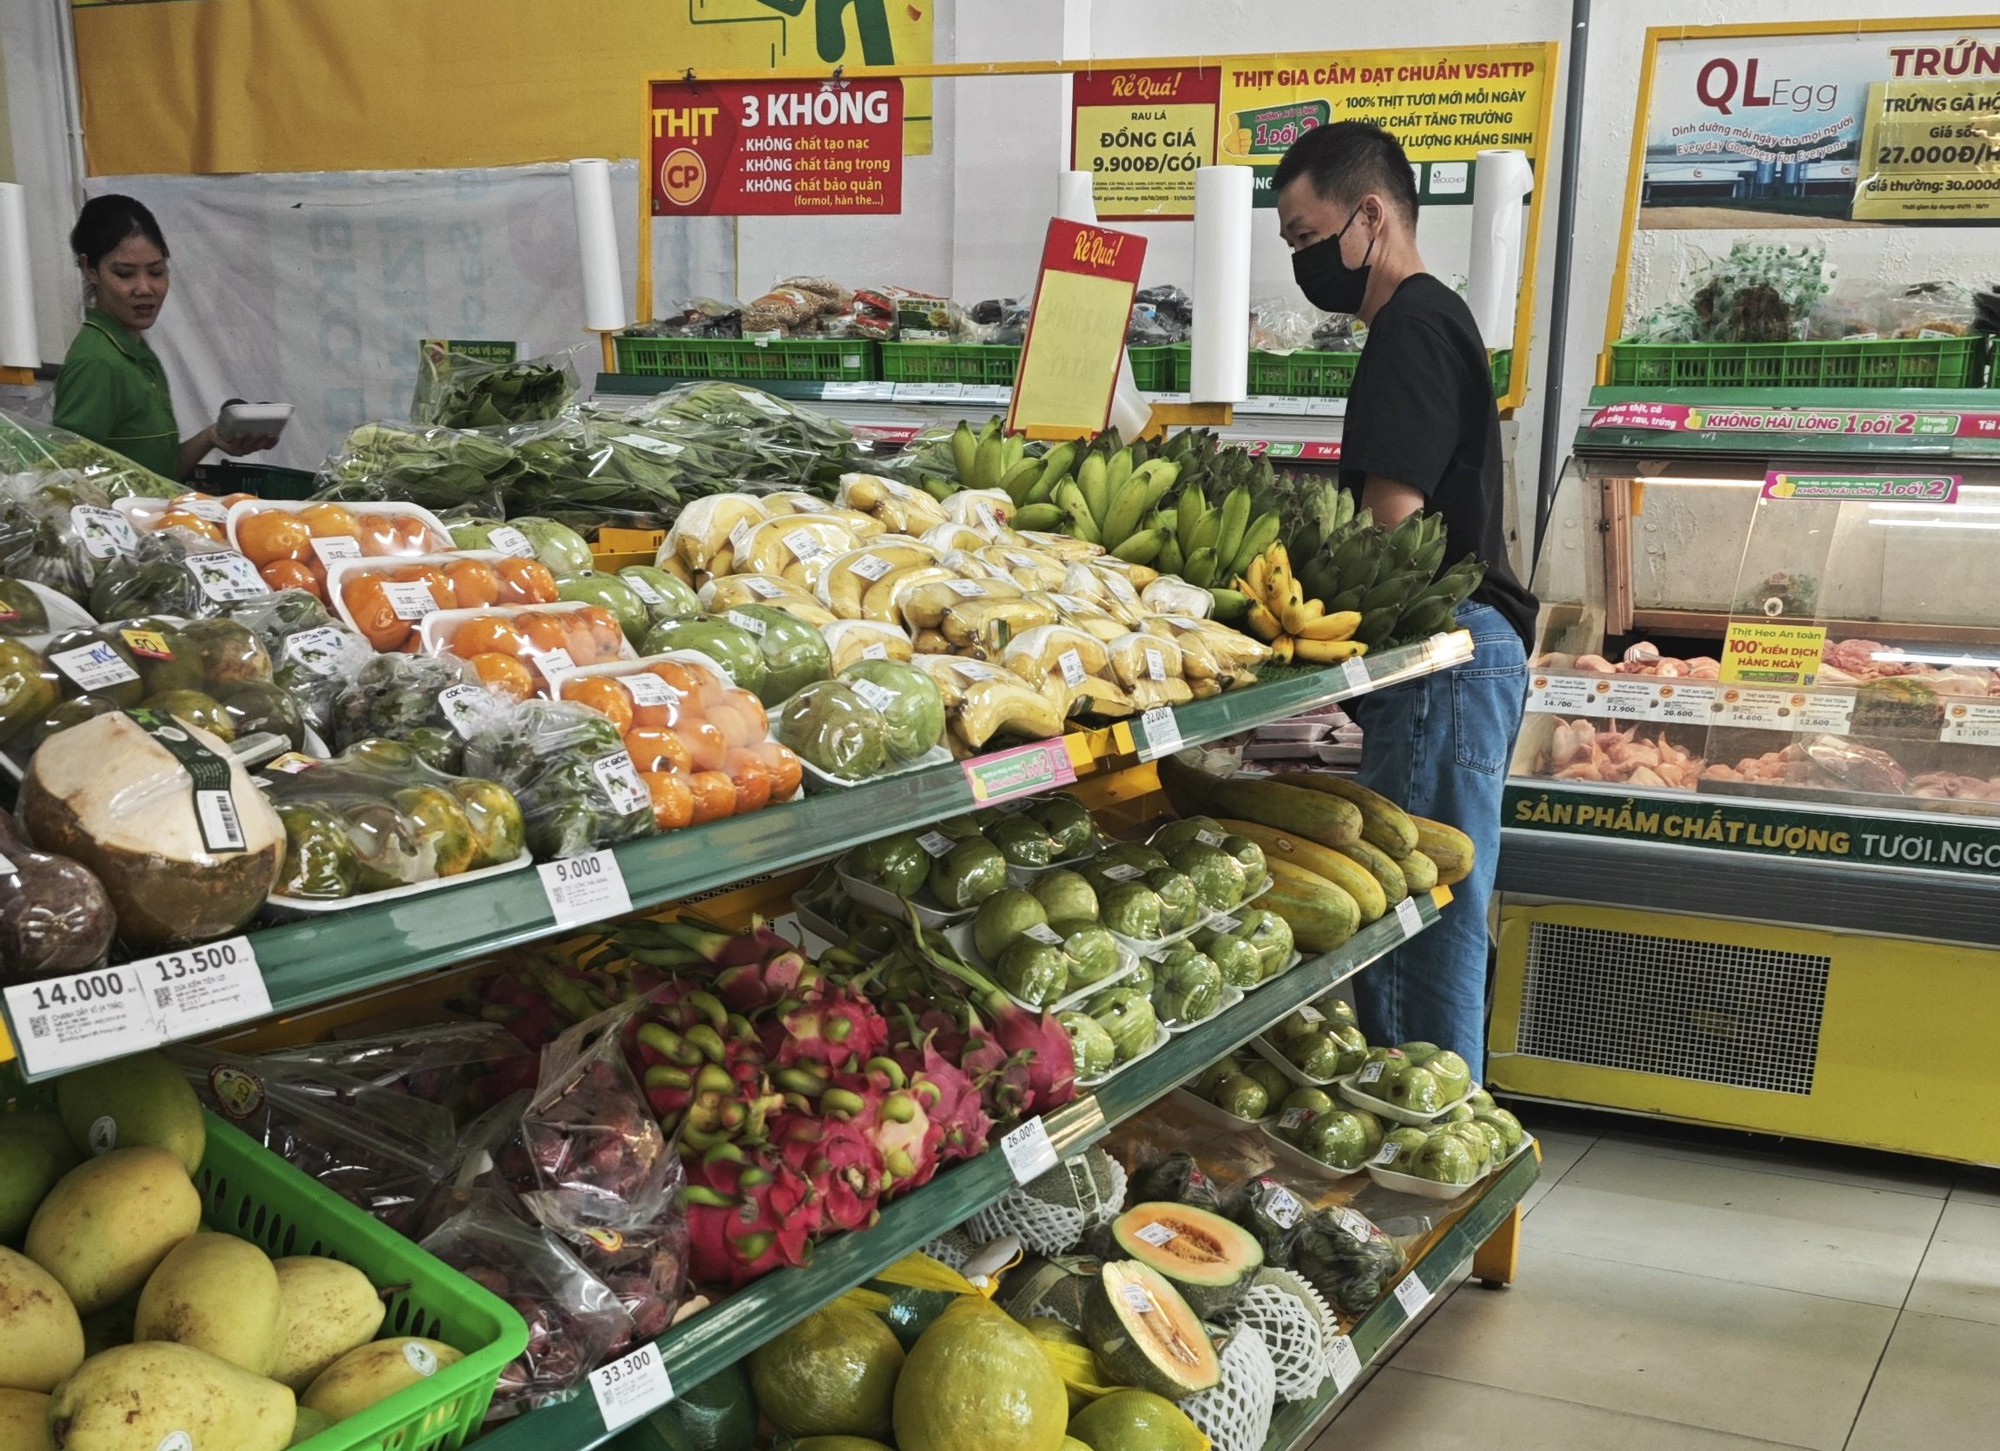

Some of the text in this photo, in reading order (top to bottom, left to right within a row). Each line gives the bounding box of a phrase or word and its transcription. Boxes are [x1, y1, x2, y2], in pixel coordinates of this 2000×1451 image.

[1137, 71, 1184, 100] Quá!
[1232, 58, 1535, 91] THỊT GIA CẦM ĐẠT CHUẨN VSATTP
[1696, 57, 1838, 115] QL Egg
[741, 85, 889, 127] 3 KHÔNG
[1345, 87, 1526, 110] 100% THỊT TƯƠI MỚI MỖI NGÀY
[1885, 93, 1947, 113] TRỨNG
[653, 107, 719, 146] THỊT
[1131, 109, 1168, 122] RAU LÁ
[1390, 110, 1513, 128] CHẤT TĂNG TRƯỞNG
[1100, 126, 1196, 148] ĐỒNG GIÁ
[1255, 123, 1267, 146] 1
[1409, 129, 1533, 151] LƯỢNG KHÁNG SINH
[1672, 123, 1696, 137] Dinh
[1698, 122, 1731, 137] dưỡng
[1753, 133, 1778, 147] ngày
[1779, 137, 1799, 147] cho
[1801, 131, 1822, 145] mọi
[1824, 115, 1855, 138] người
[1929, 125, 1953, 139] Giá
[746, 135, 870, 153] KHÔNG chất tạo nạc
[1677, 140, 1848, 163] Everyday Goodness For Everyone
[746, 155, 891, 174] KHÔNG chất tăng trọng
[667, 165, 699, 189] CP
[746, 176, 882, 196] KHÔNG chất bảo quản
[1867, 178, 1888, 192] Giá
[1890, 179, 1944, 194] thường:
[794, 194, 833, 208] (formol,
[834, 193, 854, 206] hàn
[1090, 235, 1125, 269] Quá!
[1707, 410, 1917, 434] KHÔNG HÀI LÒNG 1 ĐỔI 2
[1922, 416, 1948, 425] Trong
[1796, 486, 1830, 495] KHÔNG
[1880, 482, 1894, 496] 1
[1926, 480, 1946, 497] 2
[1732, 627, 1821, 640] Thịt Heo An toàn
[1737, 655, 1803, 669] HÀNG NGÀY
[1790, 647, 1819, 659] DỊCH
[1607, 705, 1636, 713] 12.900
[1515, 794, 1573, 826] SẢN
[1576, 797, 1660, 835] PHẨM
[1663, 809, 1745, 844] CHẤT
[1745, 823, 1851, 856] LƯỢNG
[556, 856, 601, 882] 9.000
[155, 944, 237, 982] 13.500
[32, 972, 124, 1010] 14.000
[1007, 1122, 1036, 1149] 26.000
[601, 1350, 651, 1387] 33.300
